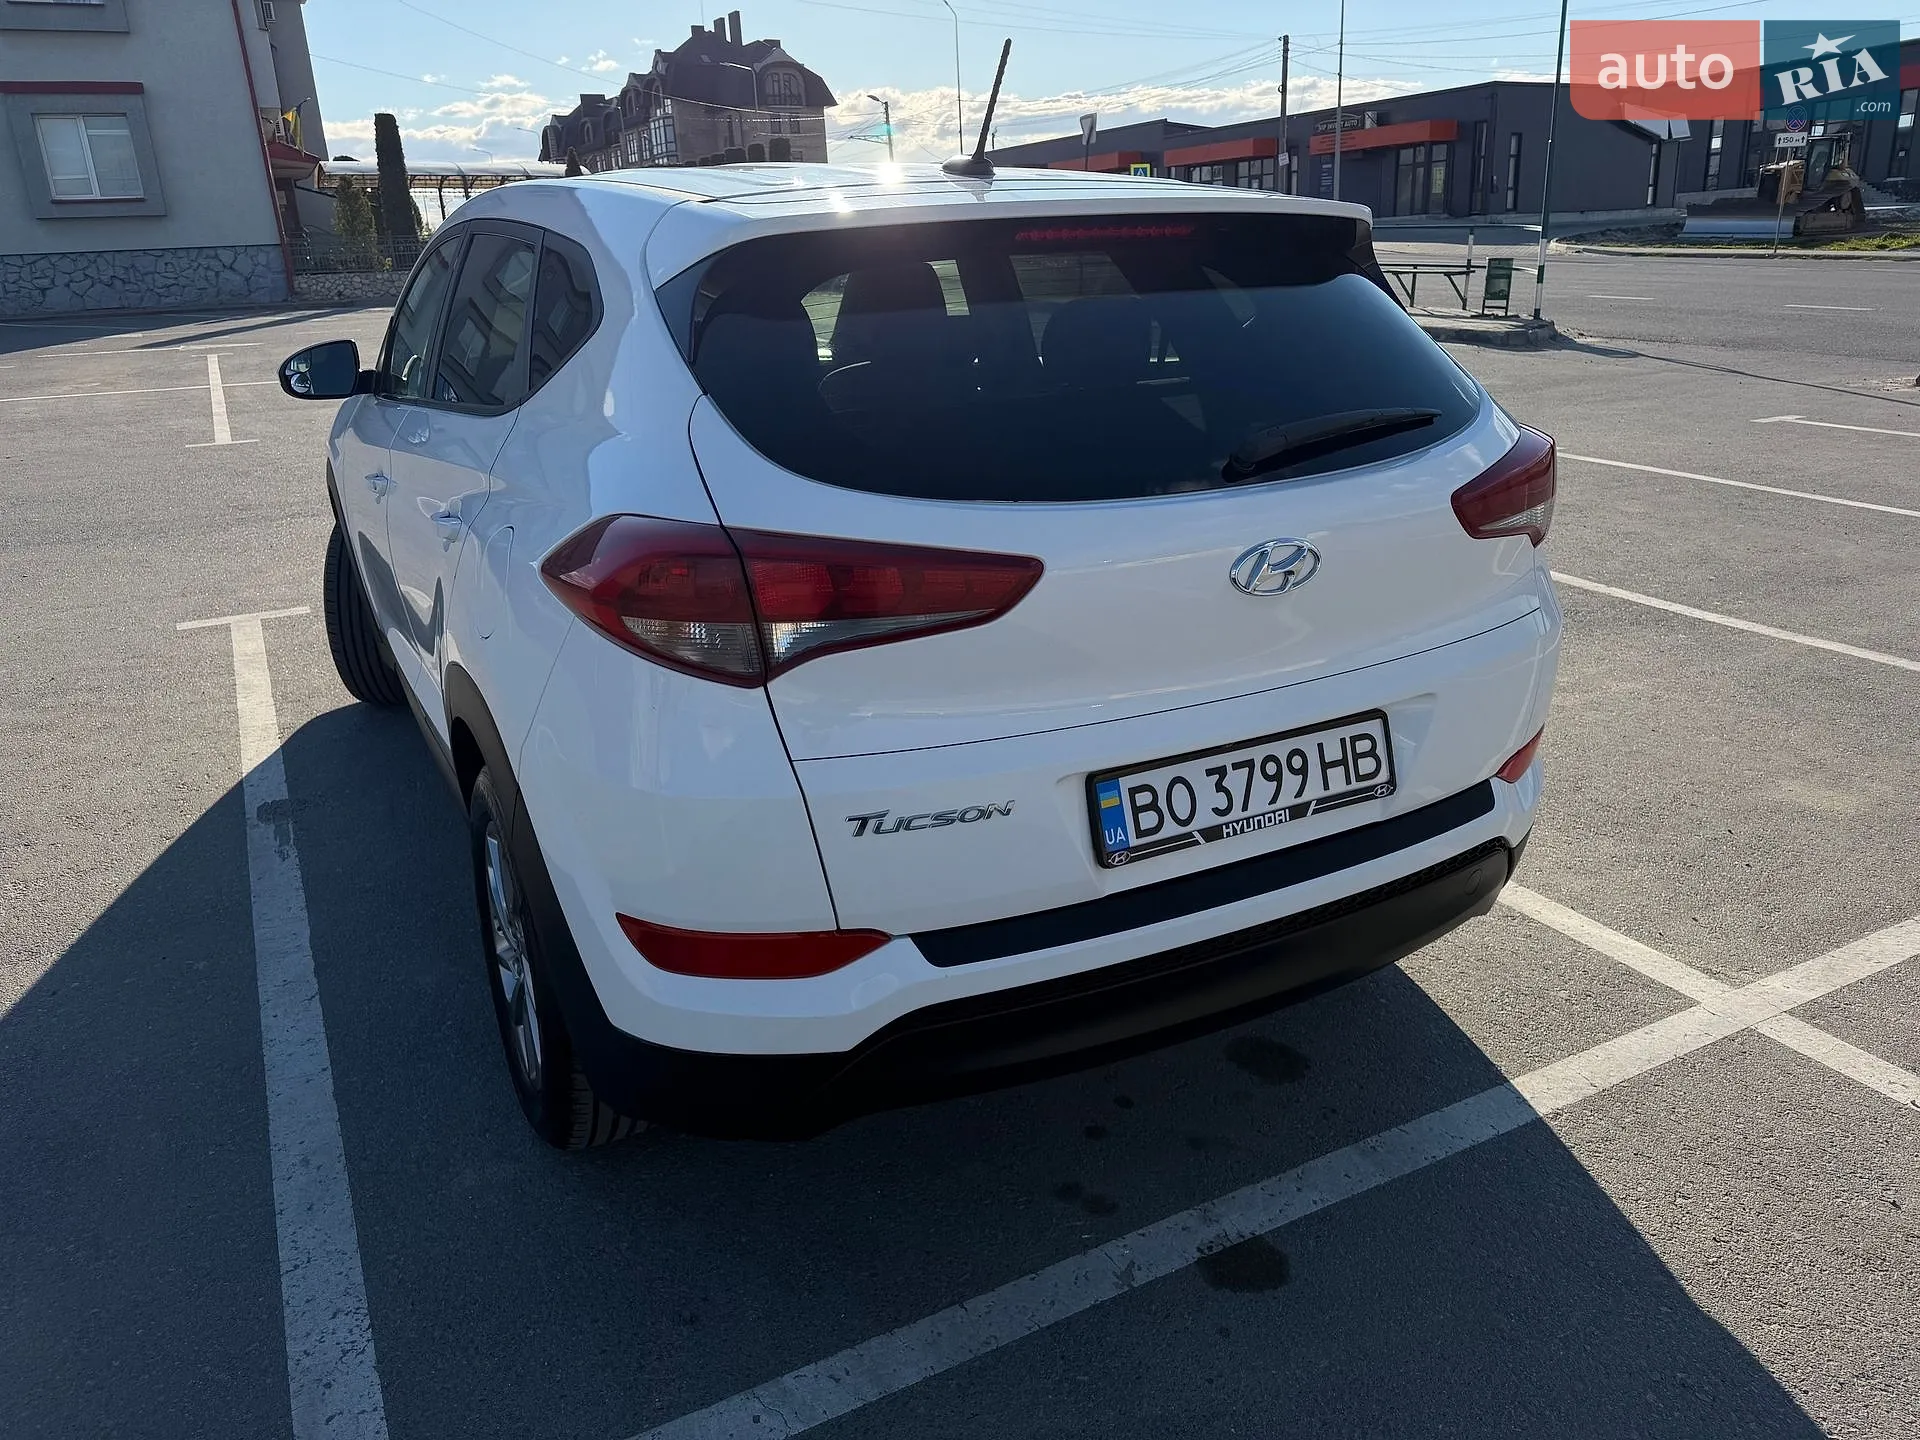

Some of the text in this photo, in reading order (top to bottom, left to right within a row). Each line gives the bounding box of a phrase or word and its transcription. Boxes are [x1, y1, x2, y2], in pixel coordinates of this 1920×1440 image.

[1782, 136, 1794, 144] 150
[1127, 732, 1382, 840] BO 3799 HB
[845, 799, 1016, 838] TUCSON
[1222, 808, 1291, 839] HYUNDAI
[1105, 828, 1126, 845] UA
